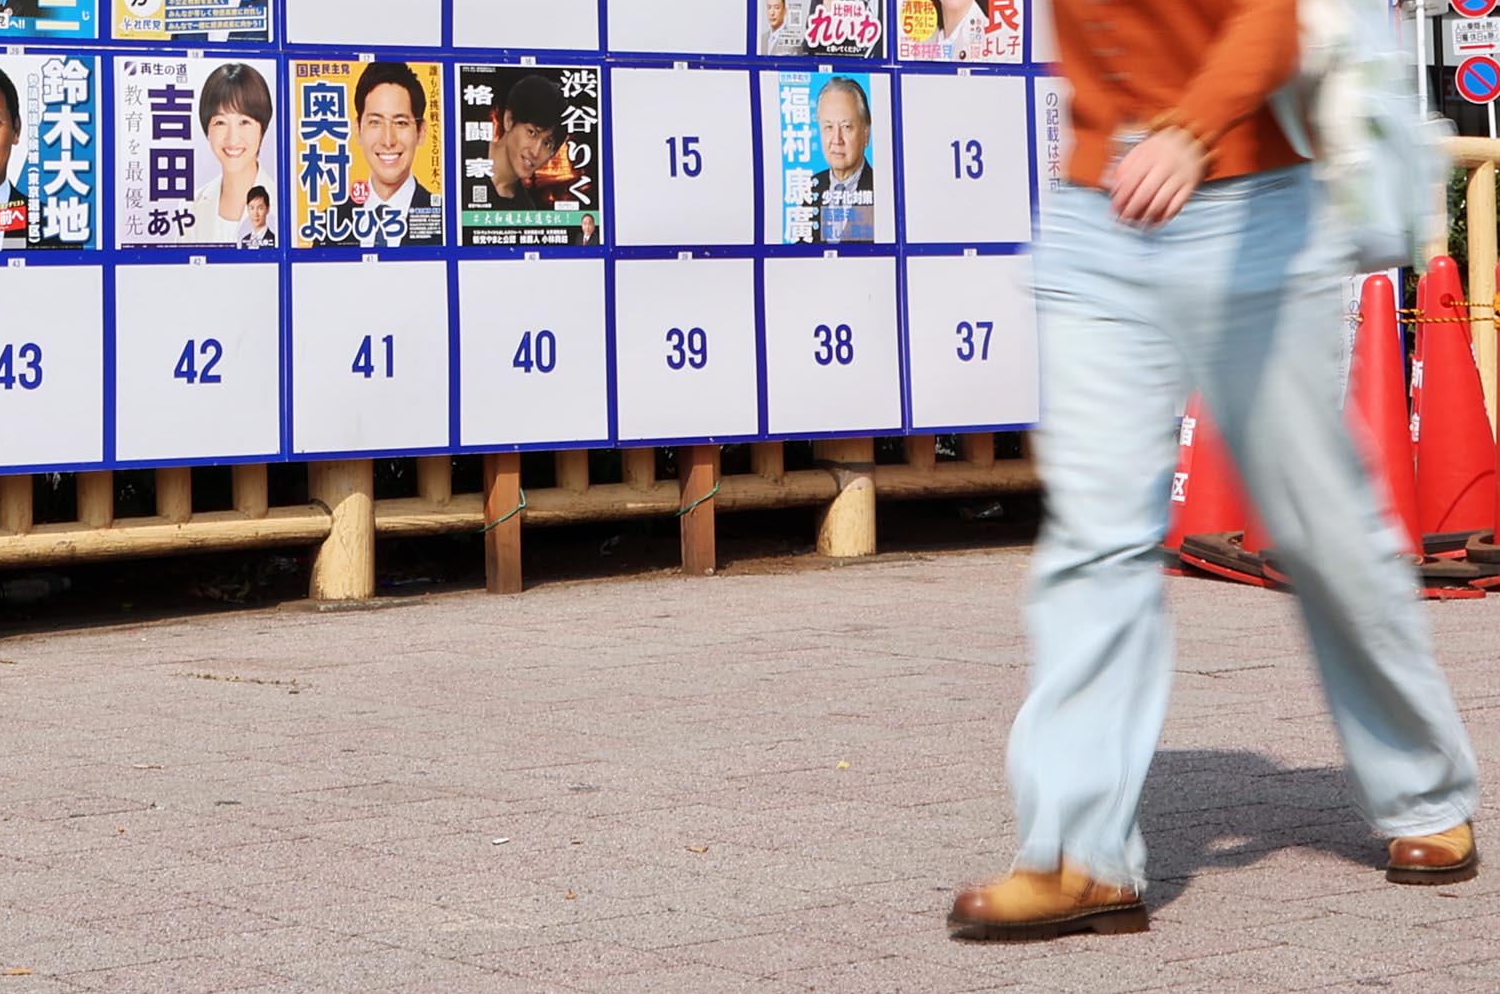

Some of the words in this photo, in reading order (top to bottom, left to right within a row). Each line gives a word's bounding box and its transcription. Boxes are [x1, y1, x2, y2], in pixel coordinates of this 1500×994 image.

[808, 8, 879, 45] れいわ
[902, 0, 935, 15] 消費税
[982, 36, 1020, 57] よし子
[141, 62, 187, 76] 再生の道
[297, 64, 350, 78] 国民民主党
[43, 58, 91, 241] 鈴木大地
[148, 85, 194, 202] 吉田
[301, 82, 350, 203] 奥村
[463, 84, 494, 179] 格闘家
[561, 70, 598, 206] 渋谷りく
[125, 85, 143, 236] 教育を最優先
[666, 136, 701, 176] 15
[951, 139, 983, 178] 13
[0, 210, 25, 225] 前へ
[821, 190, 873, 205] 少子化対策
[148, 208, 195, 236] あや
[301, 208, 406, 239] よしひろ
[172, 338, 222, 383] 42
[350, 334, 393, 377] 41
[512, 329, 556, 372] 40
[666, 326, 706, 369] 39
[814, 323, 853, 364] 38
[955, 321, 993, 360] 37
